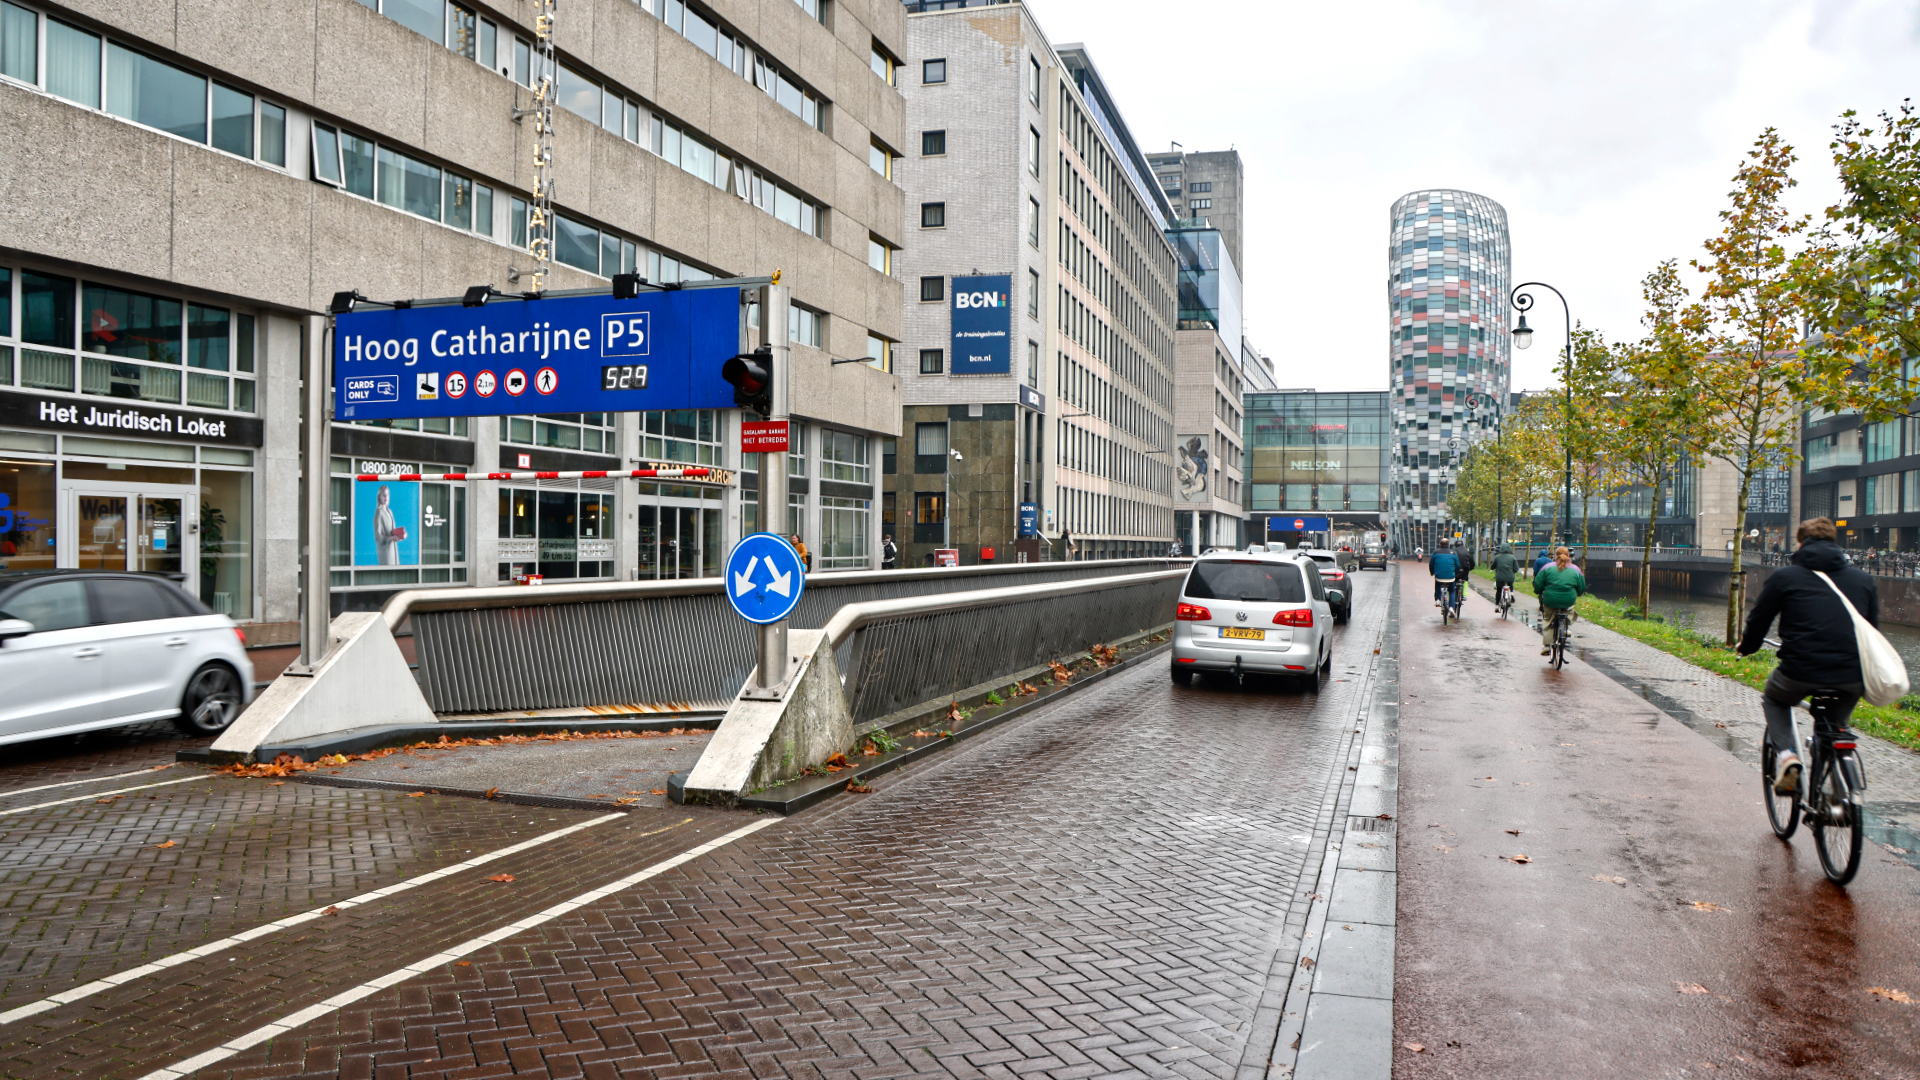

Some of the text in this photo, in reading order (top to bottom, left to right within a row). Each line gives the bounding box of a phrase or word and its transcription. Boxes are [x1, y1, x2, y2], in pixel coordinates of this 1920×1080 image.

[956, 291, 998, 309] BCN
[344, 318, 645, 366] Hoog Catharijne P5
[969, 354, 992, 362] bcn.nl
[606, 365, 648, 389] 529
[348, 380, 375, 390] CARDS
[449, 378, 464, 392] 15
[348, 390, 370, 400] ONLY
[39, 401, 226, 437] Het Juridisch Loket
[758, 436, 787, 444] BETREDEN
[361, 461, 387, 475] 0800
[1290, 460, 1341, 471] NELSON
[1225, 629, 1262, 639] 2-VRV-79
